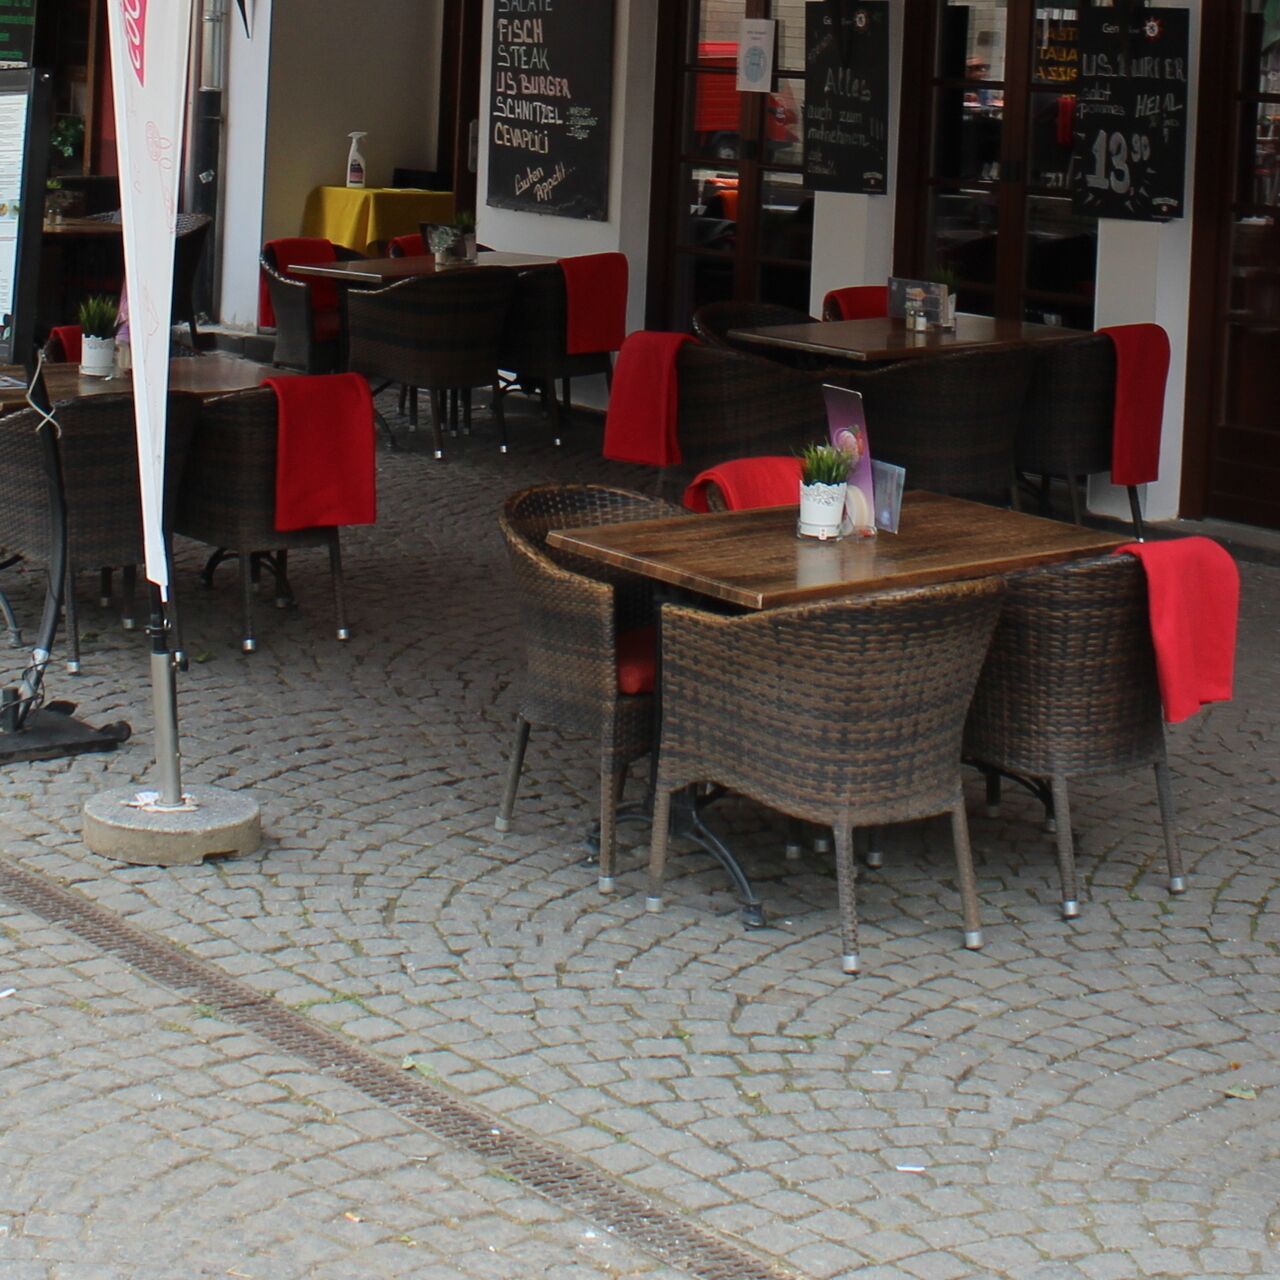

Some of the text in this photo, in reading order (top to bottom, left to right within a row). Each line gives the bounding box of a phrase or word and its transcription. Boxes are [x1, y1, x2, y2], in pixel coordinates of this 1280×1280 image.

[497, 44, 550, 71] STEAK
[1082, 53, 1112, 77] US
[496, 71, 572, 99] US BURGER
[824, 66, 872, 102] Alles
[492, 96, 563, 124] SCHNITZEL
